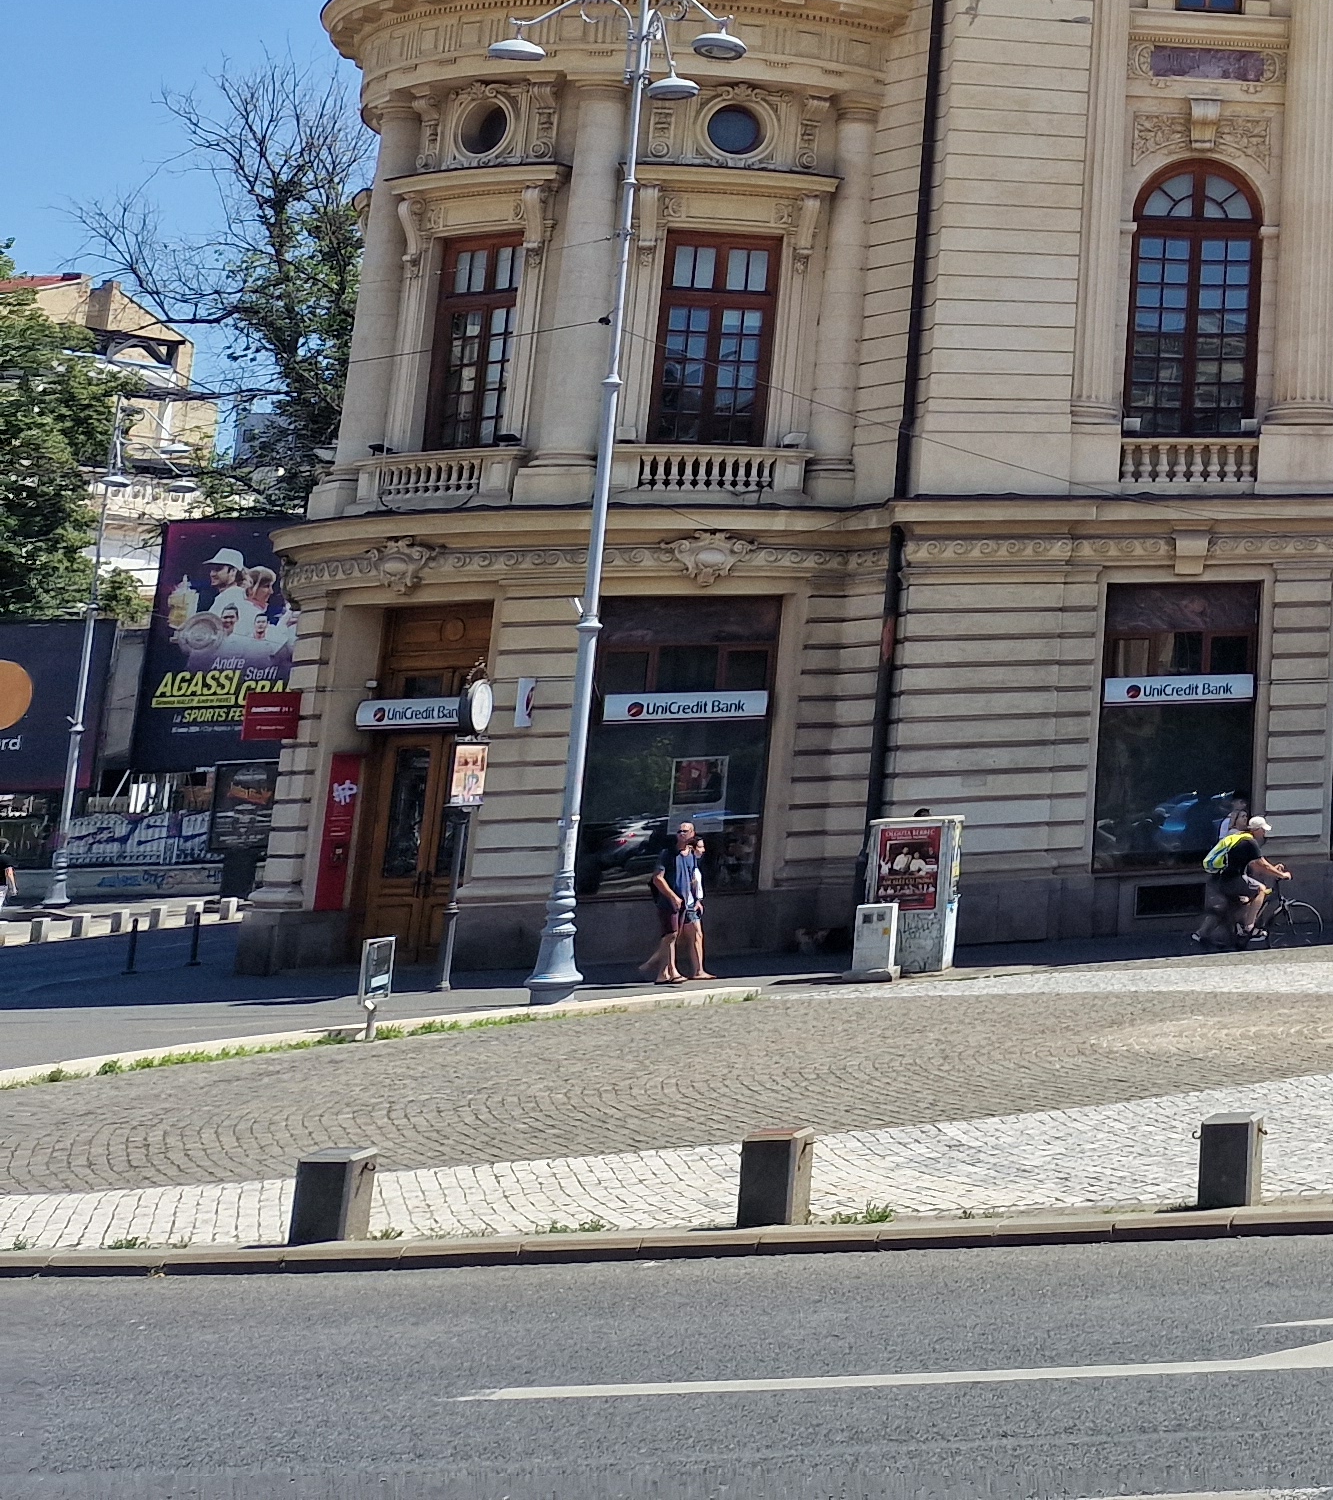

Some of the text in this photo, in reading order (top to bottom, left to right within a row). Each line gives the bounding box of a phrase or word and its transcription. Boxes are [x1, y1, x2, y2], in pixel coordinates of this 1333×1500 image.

[211, 656, 246, 670] Andre
[244, 667, 279, 680] Steffi
[155, 669, 241, 697] AGASSI
[1143, 682, 1233, 698] UniCredit Bank
[182, 707, 227, 723] SPORTS
[387, 705, 458, 721] UniCredit Ban
[646, 699, 745, 715] UniCredit Bank
